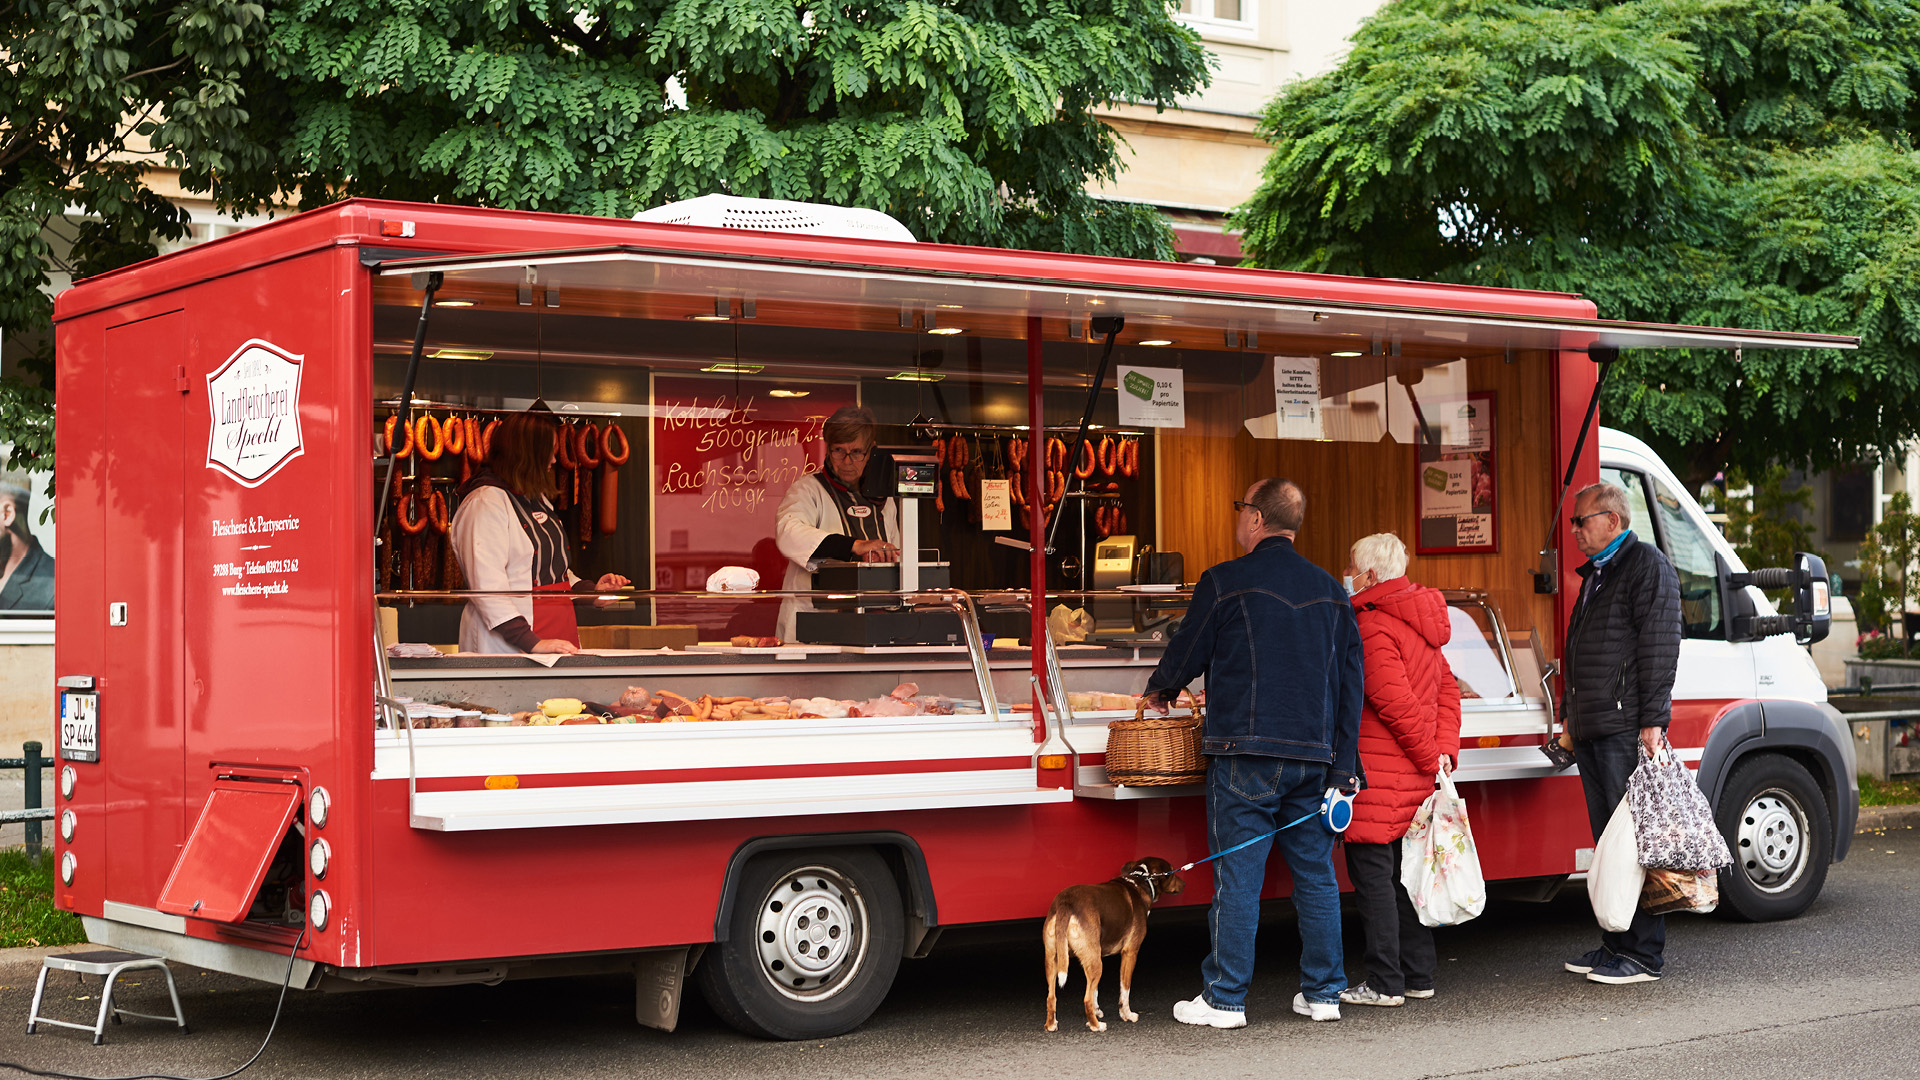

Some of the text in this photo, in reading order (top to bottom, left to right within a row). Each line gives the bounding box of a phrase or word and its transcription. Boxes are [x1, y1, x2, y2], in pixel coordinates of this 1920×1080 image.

[222, 380, 288, 425] Landfleischerei
[664, 395, 758, 431] Kotelett
[227, 412, 282, 466] Specht
[212, 514, 299, 537] Fleischerei & Partyservice
[213, 563, 229, 576] 39288
[229, 563, 242, 579] Burg
[245, 561, 265, 574] Telefon
[283, 559, 290, 572] 52
[222, 580, 288, 598] www.fleischerei-specht.de
[74, 698, 85, 720] JL
[64, 724, 93, 746] SP 444
